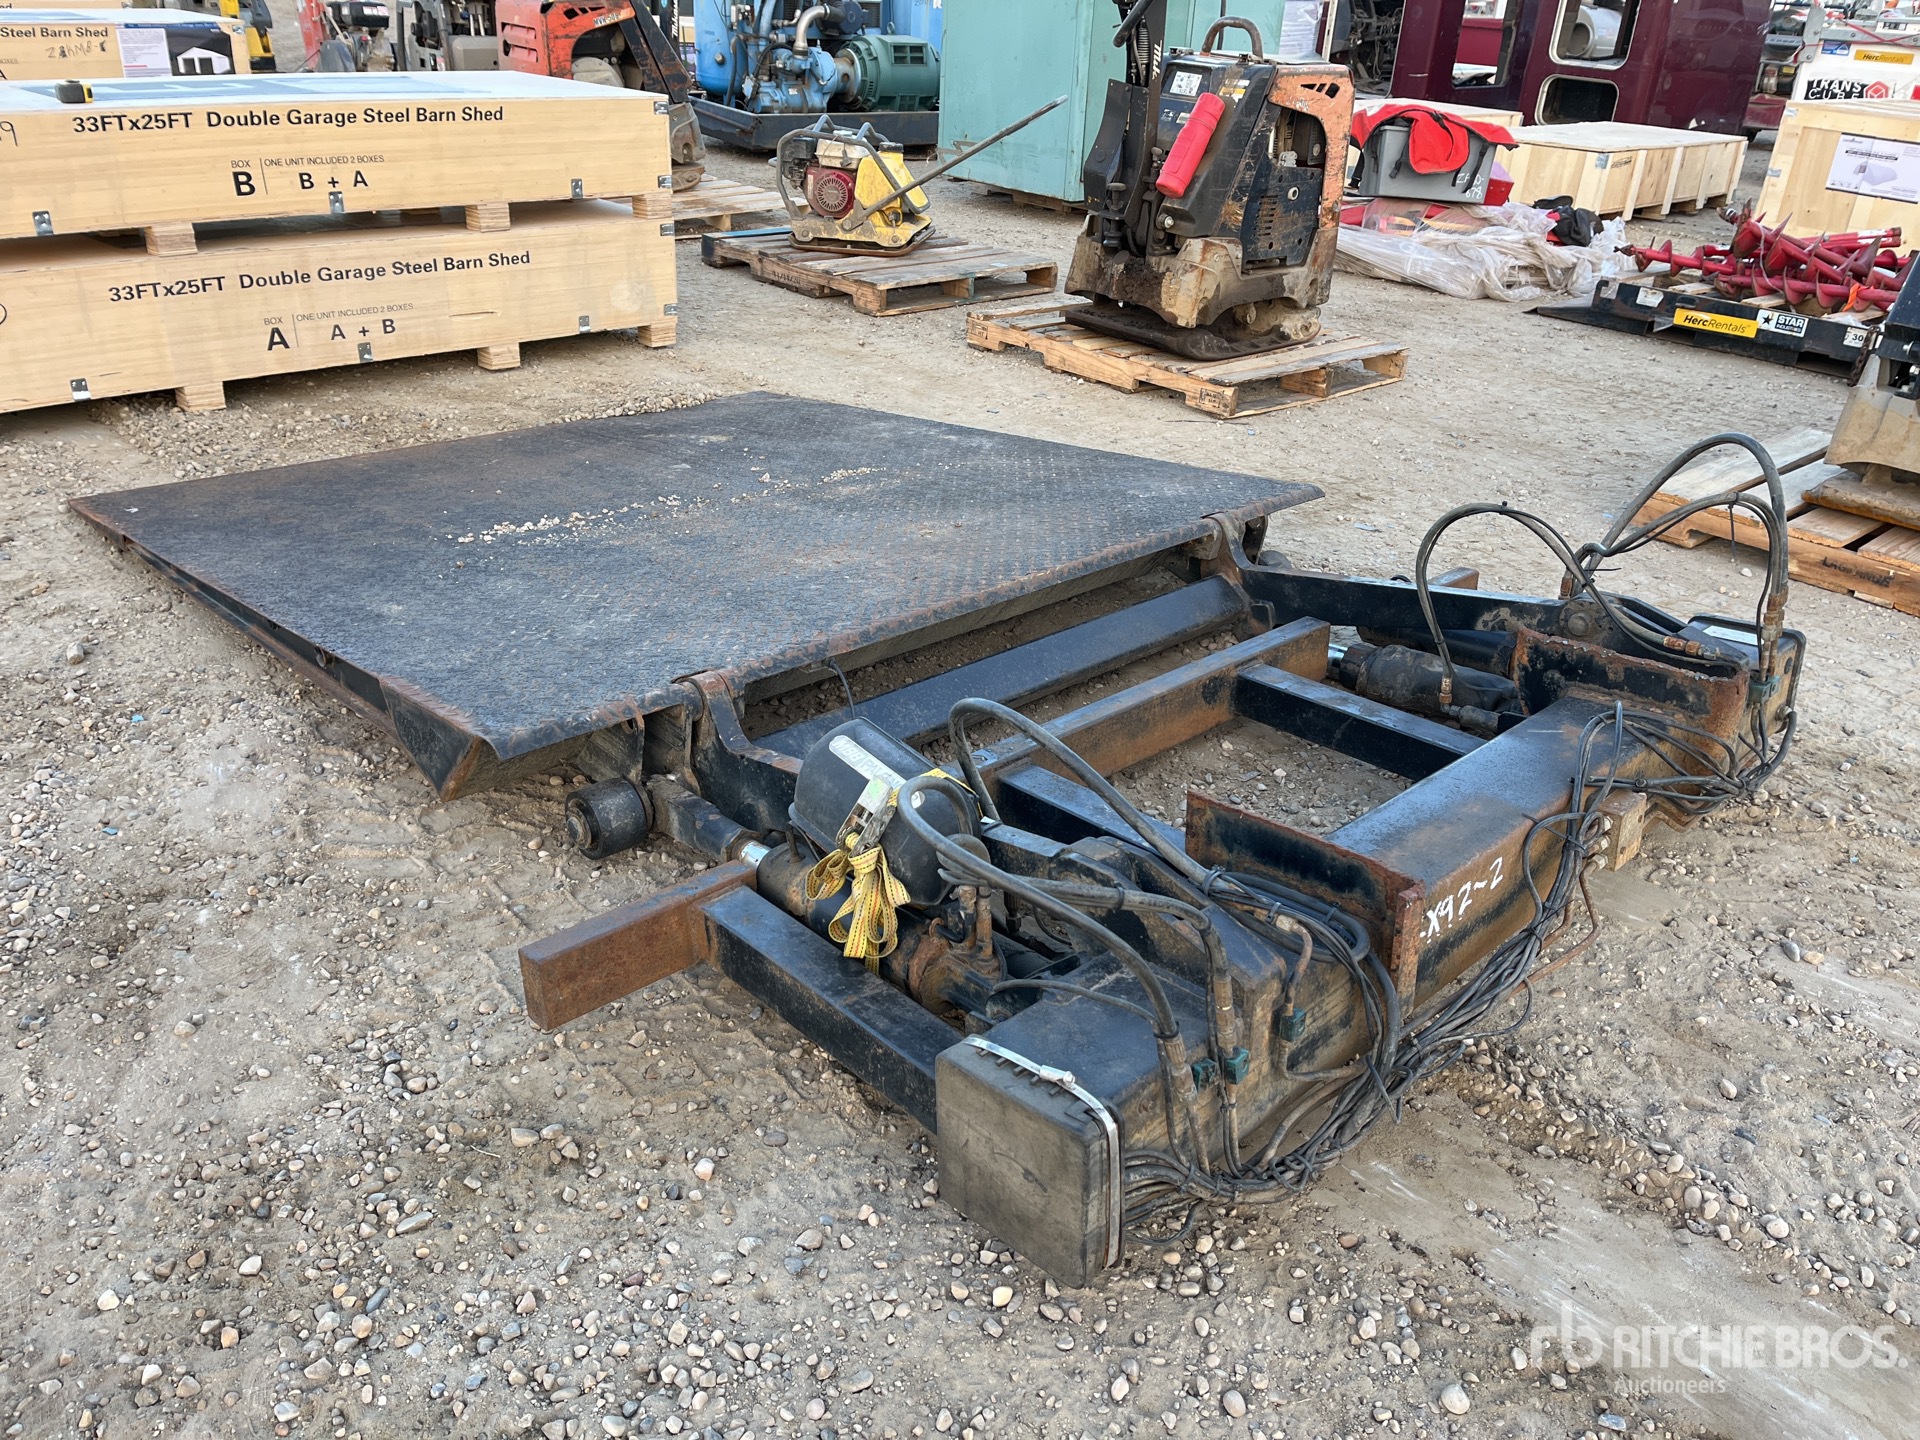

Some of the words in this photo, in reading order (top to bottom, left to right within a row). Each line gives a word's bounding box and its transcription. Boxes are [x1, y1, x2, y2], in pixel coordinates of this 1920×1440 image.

[0, 27, 36, 38] Steel
[41, 27, 71, 37] Barn
[75, 27, 108, 37] Shed
[1812, 78, 1862, 92] TRANS
[72, 112, 193, 133] 33FTx25FT
[206, 110, 280, 127] Double
[286, 108, 357, 127] Garage
[363, 107, 410, 123] Steel
[416, 107, 456, 122] Barn
[461, 106, 503, 121] Shed
[231, 160, 251, 169] BOX
[264, 158, 283, 167] ONE
[285, 157, 304, 166] UNIT
[306, 156, 349, 165] INCLUDED
[350, 156, 356, 164] 2
[357, 154, 385, 163] BOXES
[232, 171, 256, 197] B
[299, 172, 315, 190] B
[353, 170, 368, 187] A
[108, 276, 226, 302] 33FTx25FT
[239, 269, 311, 289] Double
[317, 265, 386, 282] Garage
[391, 258, 438, 275] Steel
[443, 256, 483, 271] Barn
[488, 251, 531, 267] Shed
[264, 316, 283, 325] BOX
[296, 312, 316, 322] ONE
[317, 310, 336, 320] UNIT
[337, 306, 379, 318] INCLUDED
[380, 305, 386, 313] 2
[387, 302, 414, 312] BOXES
[1777, 315, 1805, 328] STAR
[330, 324, 346, 341] A
[382, 318, 396, 335] B
[1683, 314, 1747, 334] HercRentals
[267, 327, 290, 351] A
